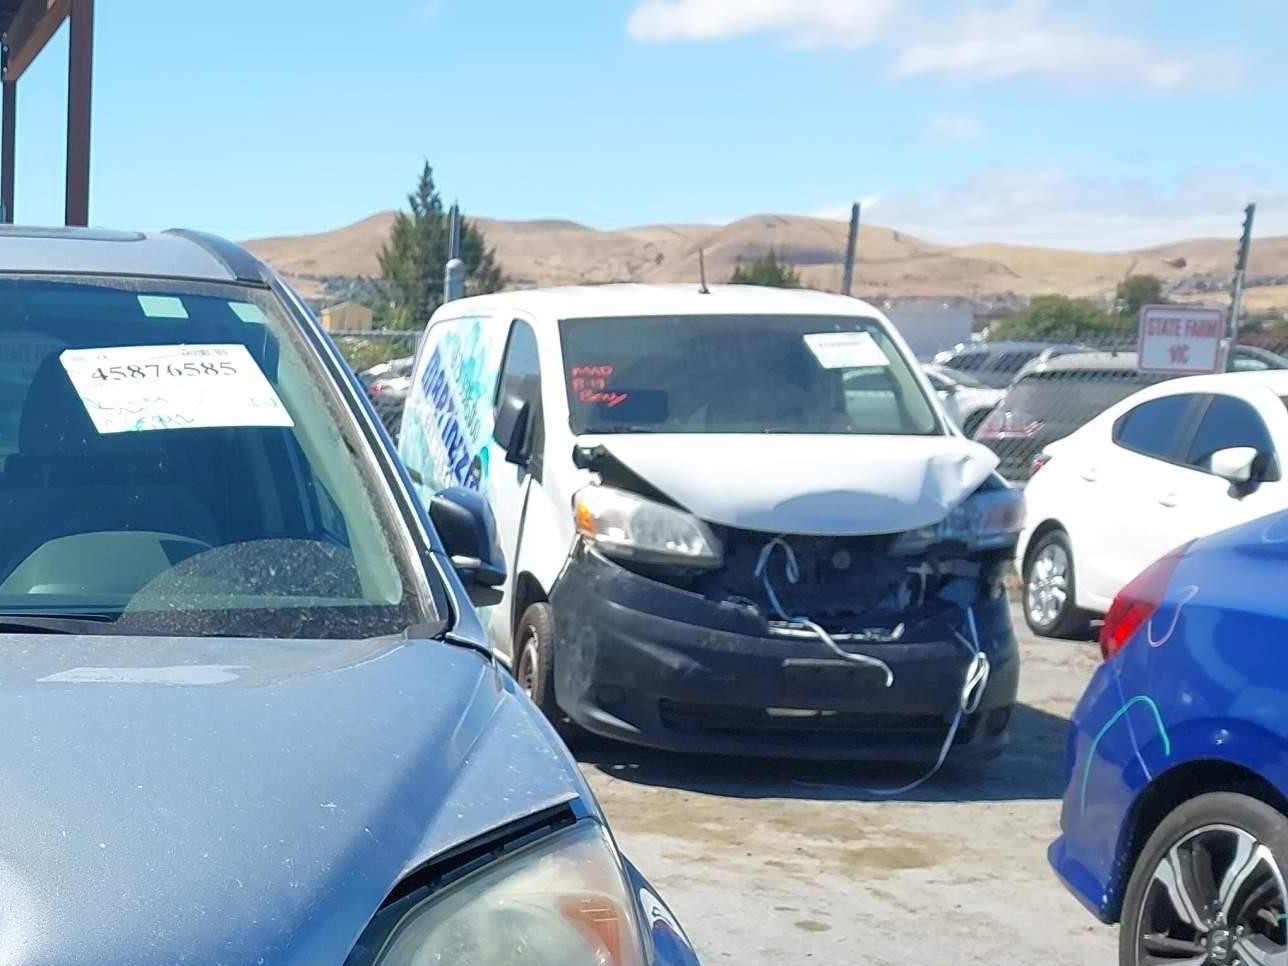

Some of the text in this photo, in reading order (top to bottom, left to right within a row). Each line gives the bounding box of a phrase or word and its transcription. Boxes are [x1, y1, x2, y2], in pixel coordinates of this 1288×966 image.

[1148, 318, 1219, 338] STATE FARM
[90, 361, 237, 382] 45876585
